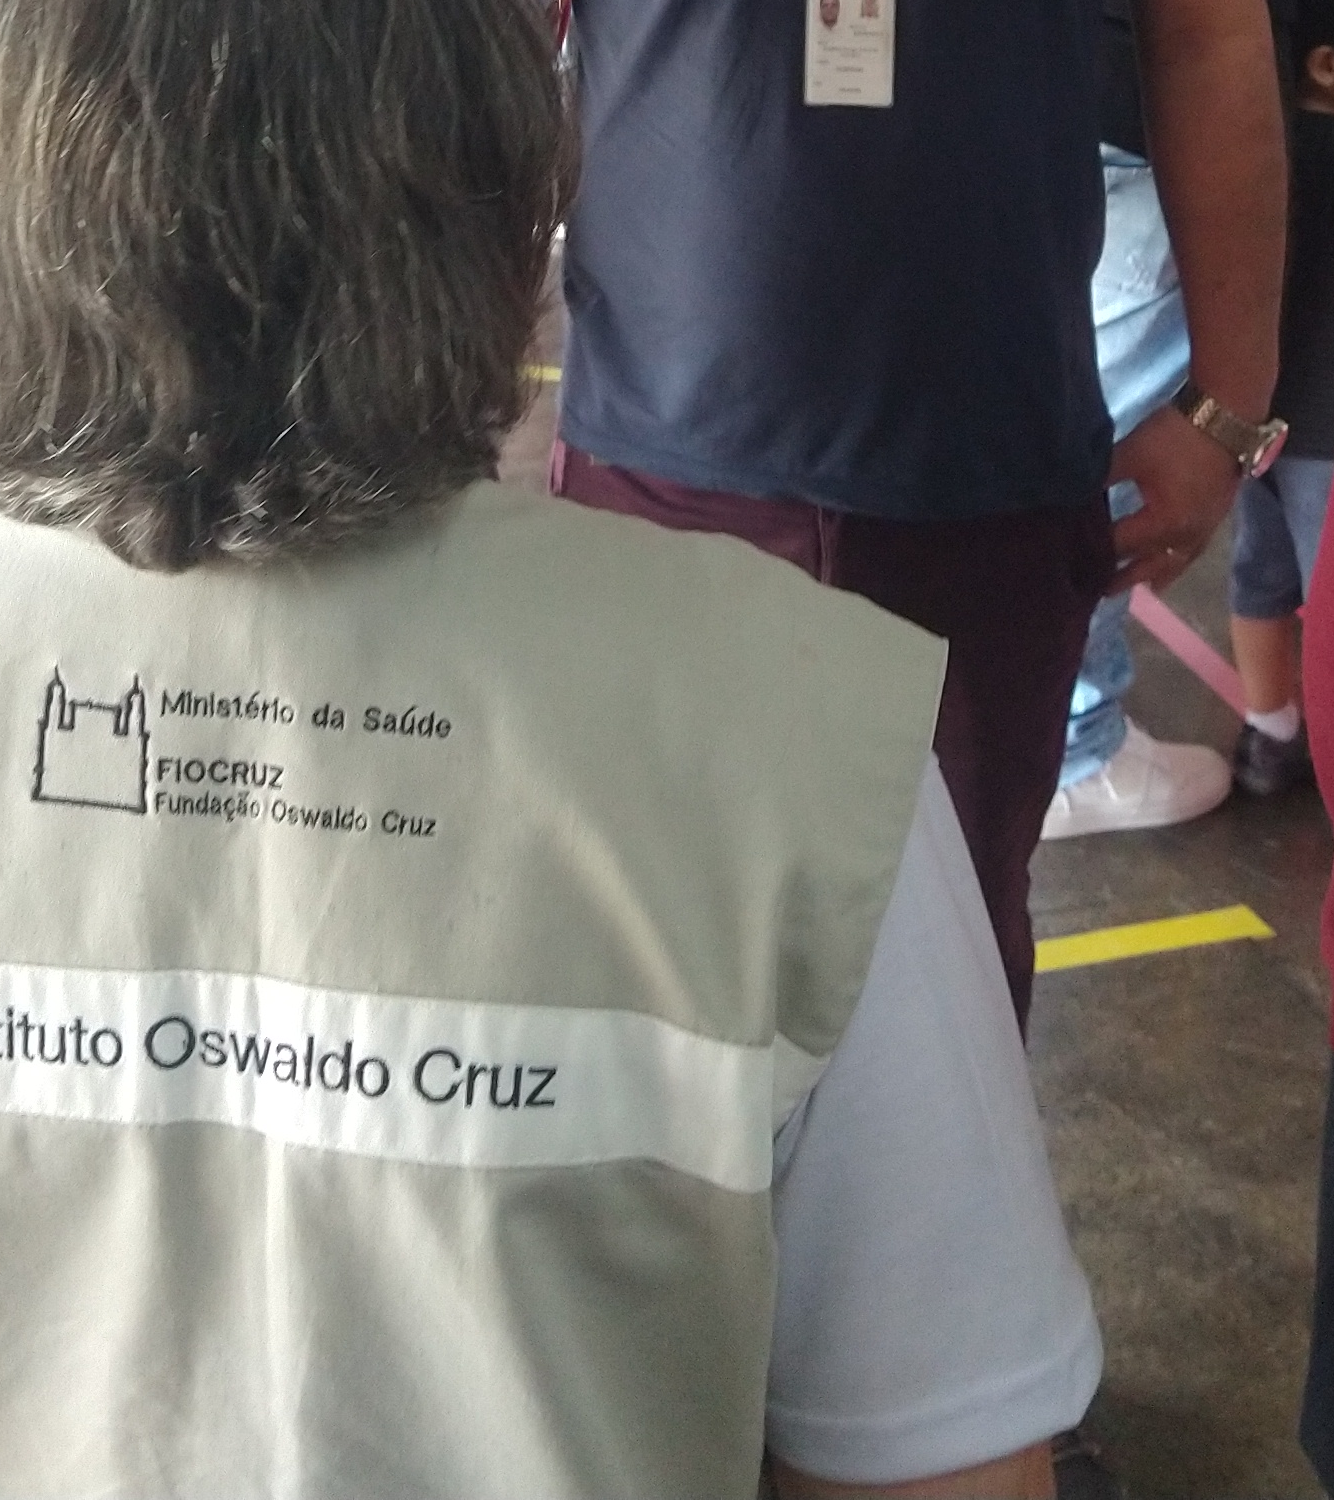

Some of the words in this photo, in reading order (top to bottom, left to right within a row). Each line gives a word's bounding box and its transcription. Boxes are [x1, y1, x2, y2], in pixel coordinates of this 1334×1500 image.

[160, 688, 296, 726] Ministério
[311, 702, 346, 731] da
[362, 704, 452, 739] Saúde
[157, 756, 285, 790] FIOCRUZ
[154, 790, 261, 824] Fundação
[270, 799, 368, 833] Oswaldo
[380, 808, 437, 838] Cruz
[143, 1014, 392, 1098] Oswaldo
[412, 1047, 559, 1112] Cruz
